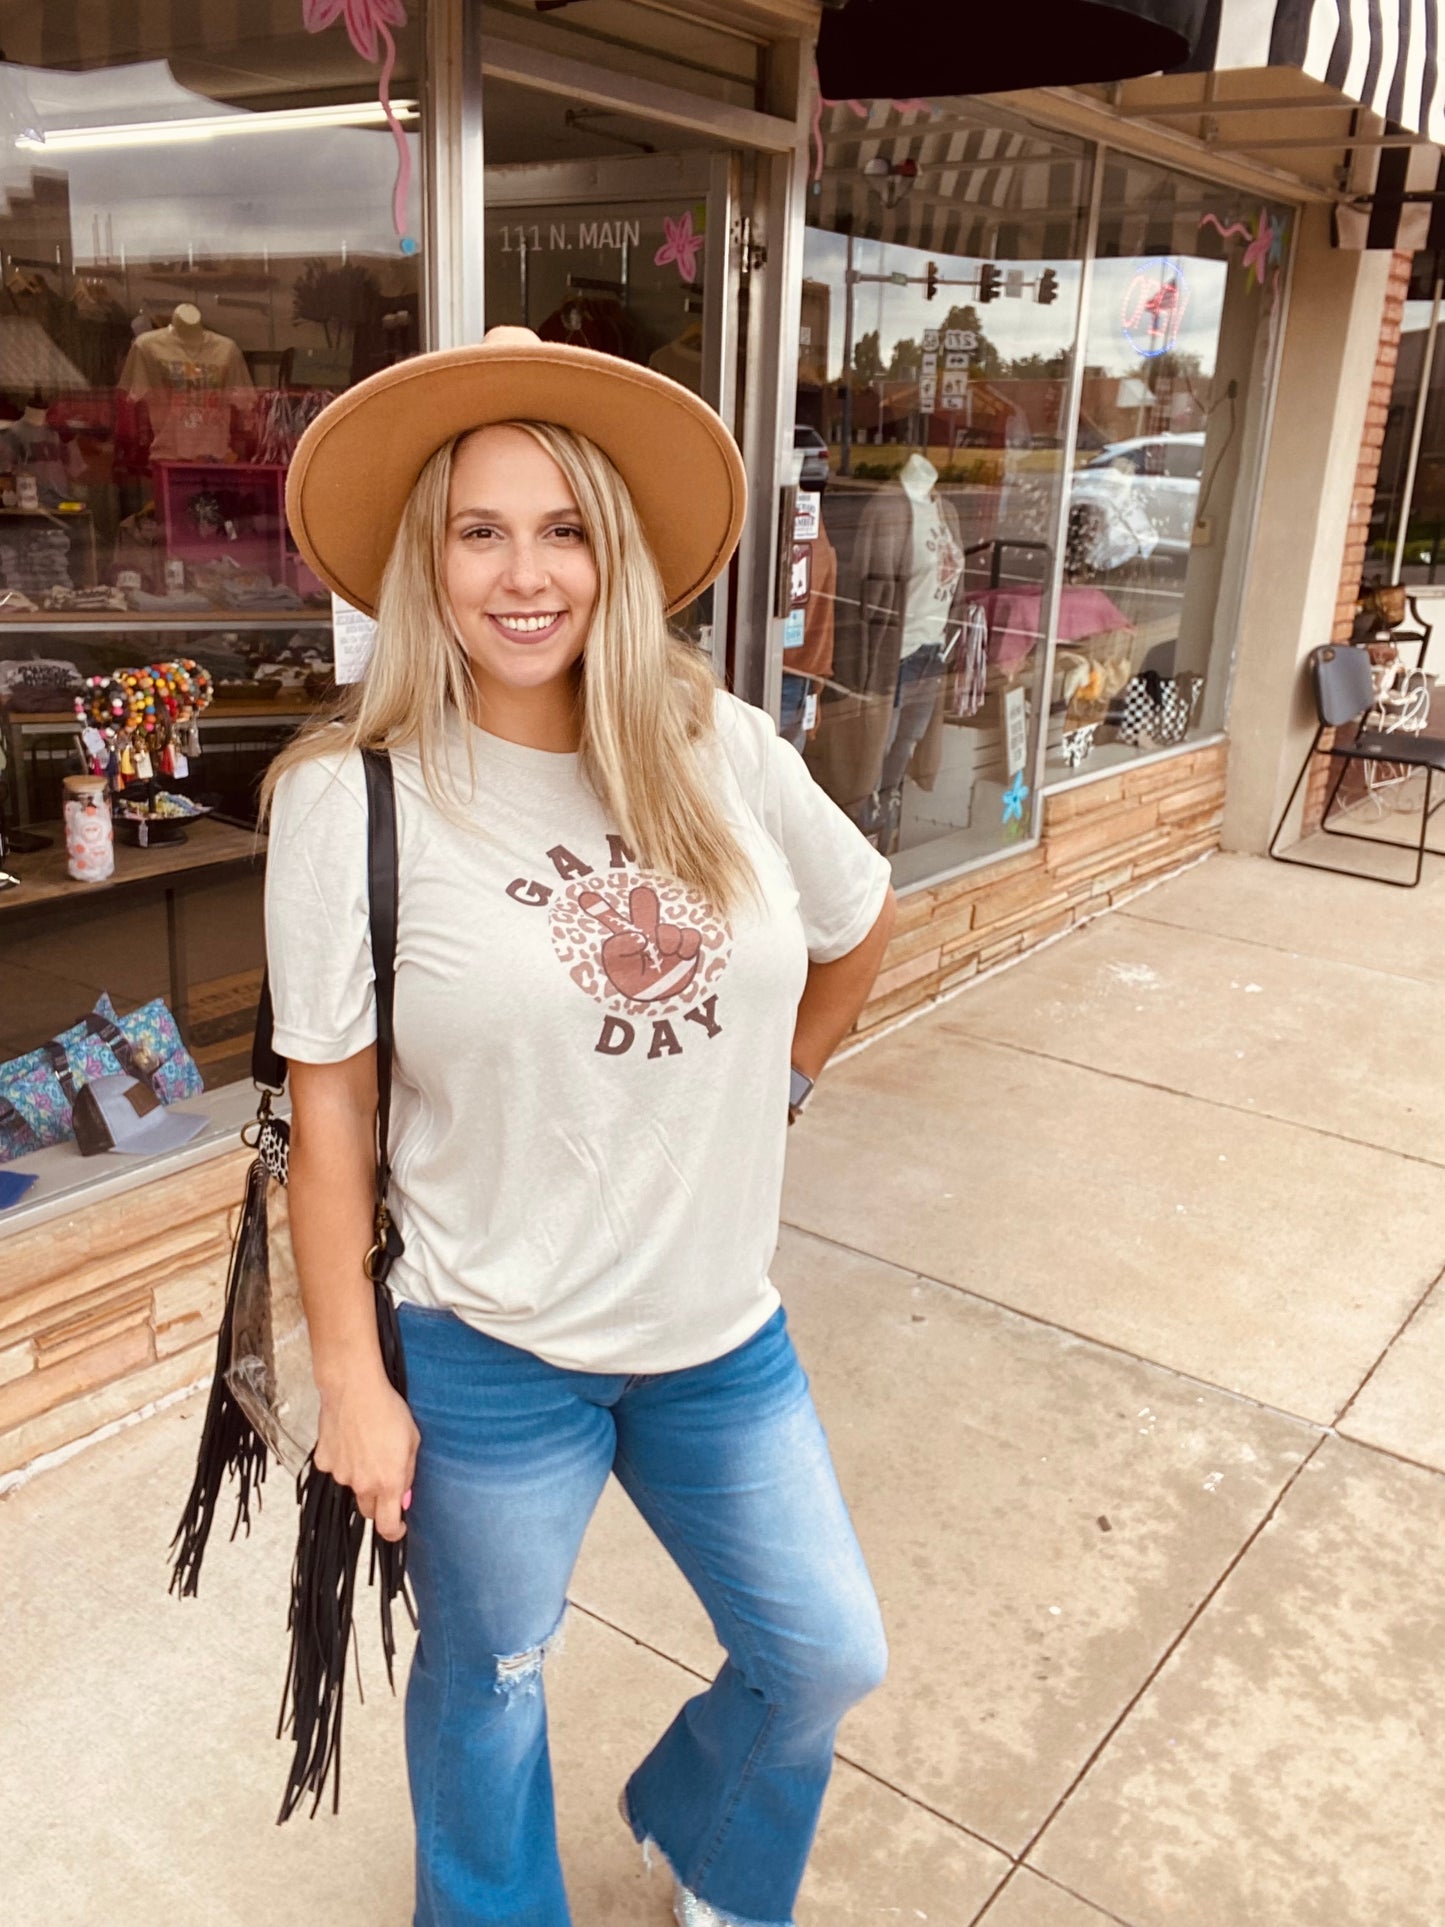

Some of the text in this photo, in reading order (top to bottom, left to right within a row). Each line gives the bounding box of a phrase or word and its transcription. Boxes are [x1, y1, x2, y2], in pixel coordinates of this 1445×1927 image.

[499, 220, 640, 252] 111 N. MAIN
[505, 834, 655, 907] GAM
[594, 994, 723, 1060] DAY
